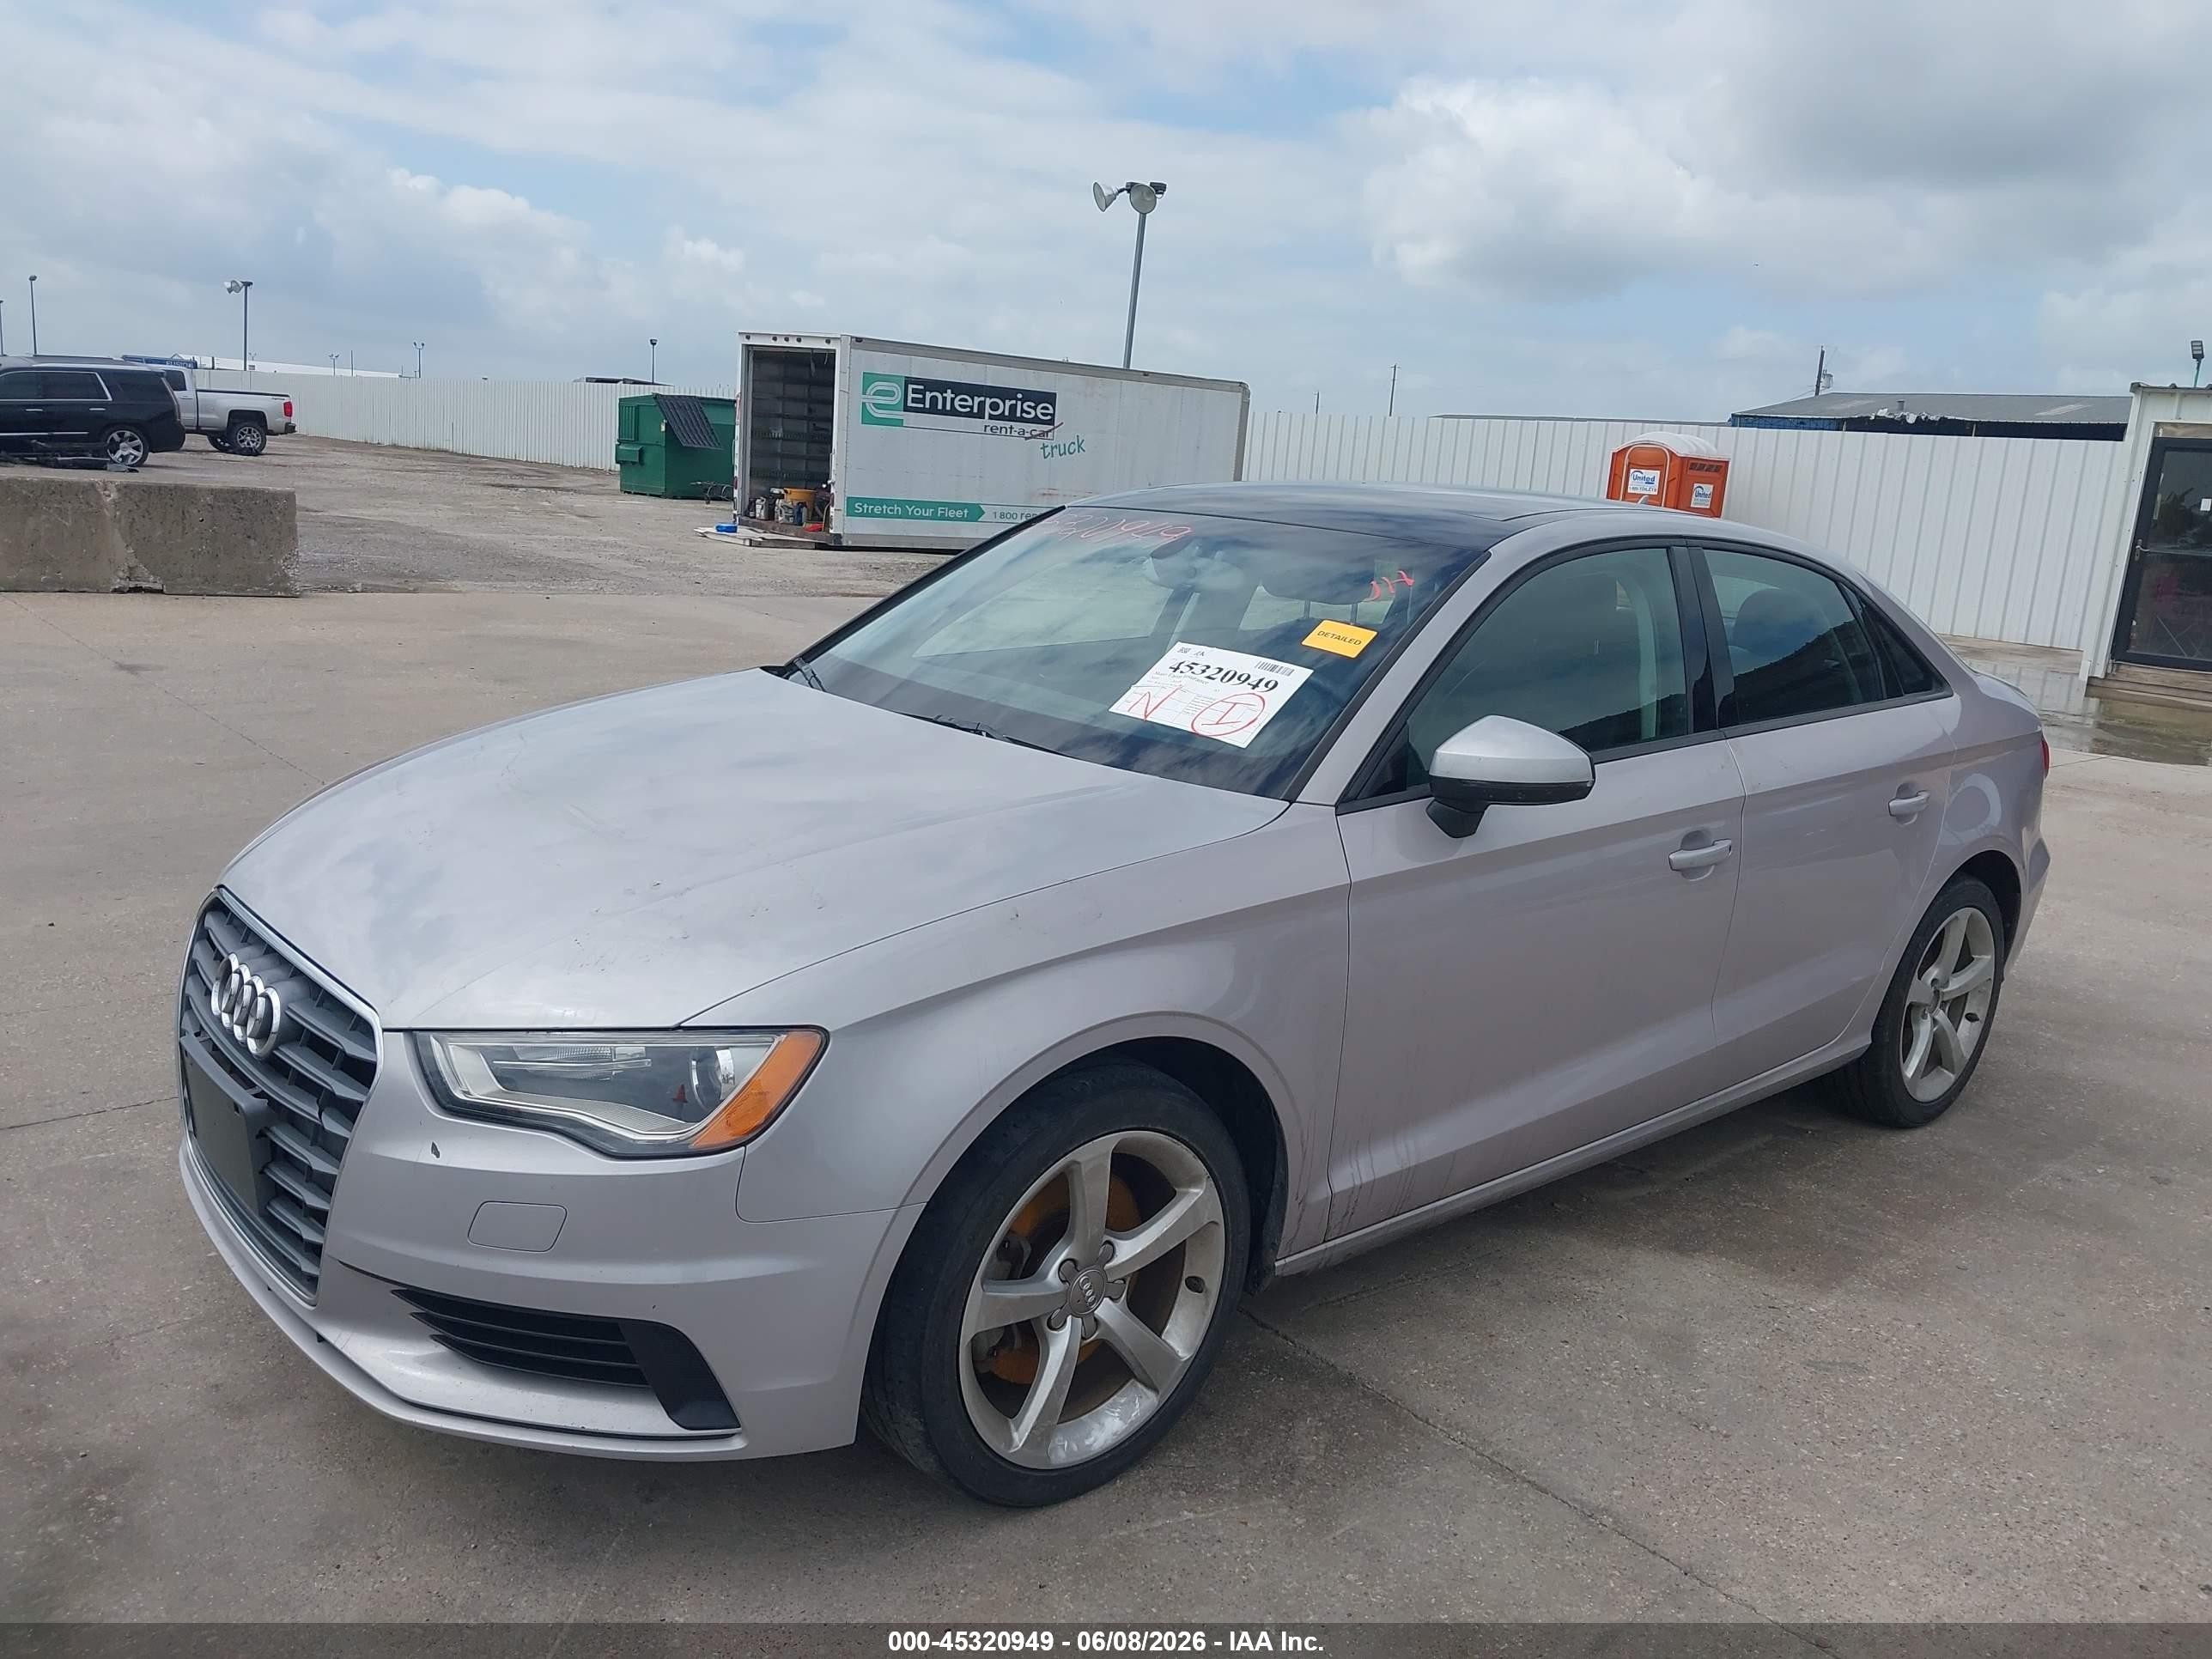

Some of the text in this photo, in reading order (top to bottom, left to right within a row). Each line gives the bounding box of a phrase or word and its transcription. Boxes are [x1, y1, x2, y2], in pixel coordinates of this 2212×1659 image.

[906, 384, 1054, 421] Enterprise
[983, 423, 1052, 438] rent-a-car
[1040, 434, 1086, 459] truck
[1632, 473, 1656, 483] United
[854, 502, 902, 515] Stretch
[905, 505, 935, 517] Your
[938, 507, 969, 519] Fleet
[999, 512, 1018, 520] 800
[1316, 630, 1362, 646] DETAILED
[1168, 659, 1279, 694] 45320949
